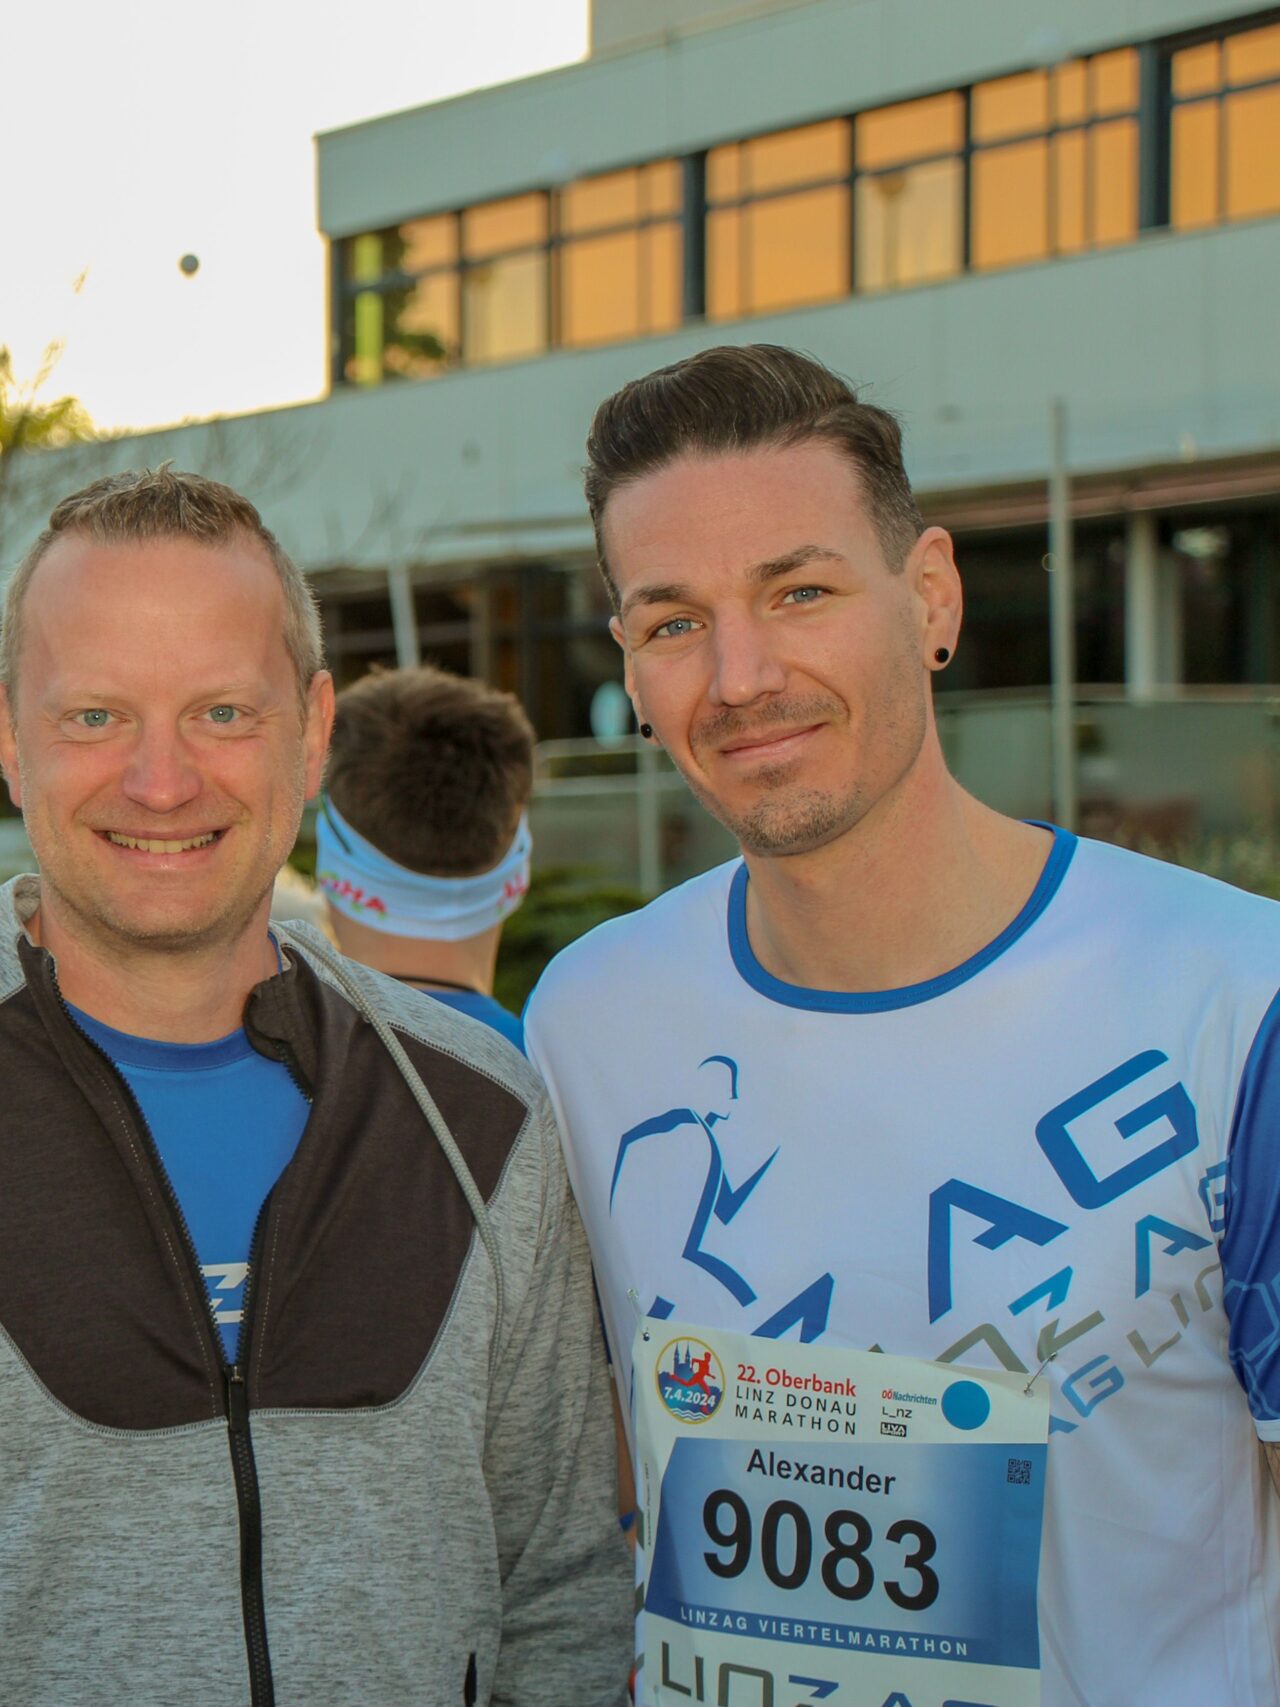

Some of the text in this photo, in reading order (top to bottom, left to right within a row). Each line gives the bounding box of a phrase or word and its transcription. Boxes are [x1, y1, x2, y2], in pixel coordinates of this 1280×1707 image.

[929, 1049, 1200, 1325] AG
[664, 1386, 717, 1408] 7.4.2024
[736, 1363, 857, 1397] 22. Oberbank
[734, 1404, 857, 1436] MARATHON
[735, 1386, 857, 1417] LINZ DONAU
[746, 1448, 896, 1495] Alexander
[703, 1488, 940, 1612] 9083
[680, 1606, 969, 1657] LINZAG VIERTELMARATHON
